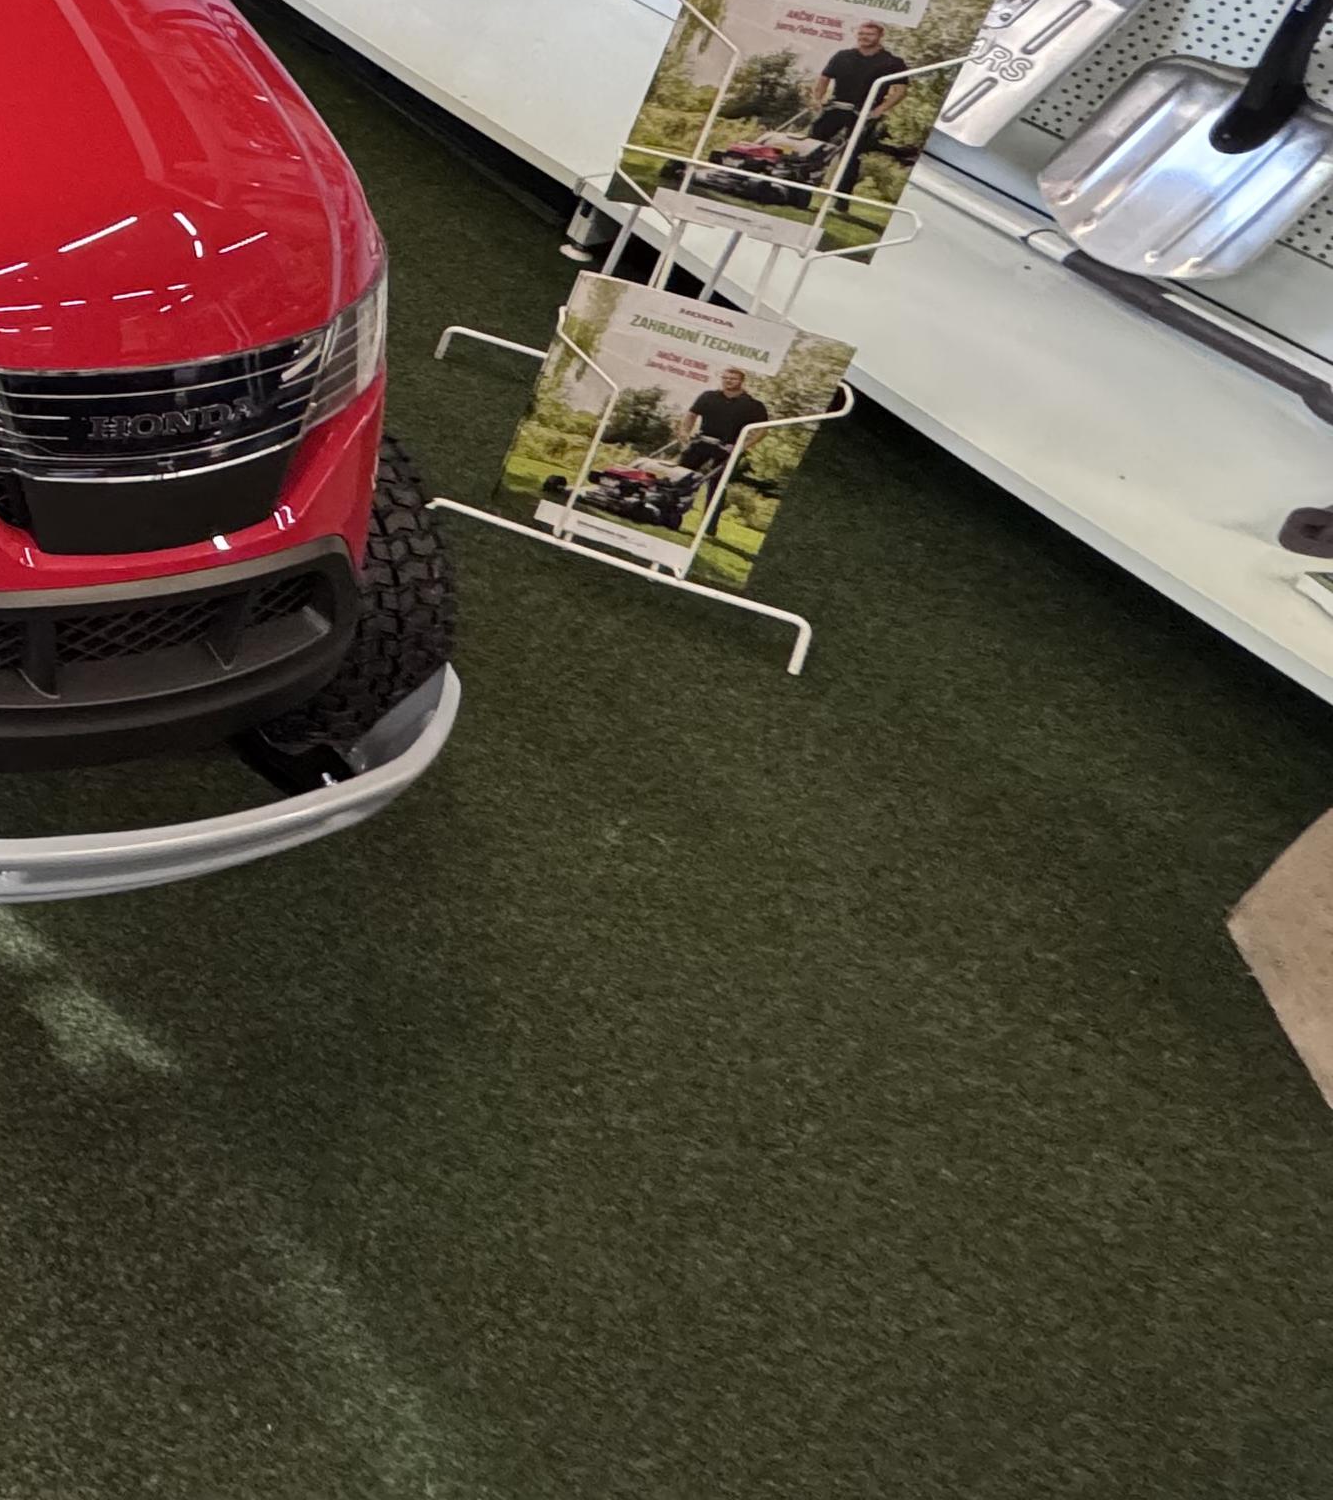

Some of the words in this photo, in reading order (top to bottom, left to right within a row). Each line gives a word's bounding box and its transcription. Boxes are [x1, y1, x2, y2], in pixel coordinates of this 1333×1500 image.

[630, 314, 703, 344] ZAHRADNÍ
[701, 334, 771, 364] TECHNIKA
[678, 308, 735, 328] HONDA
[87, 396, 263, 441] HONDA
